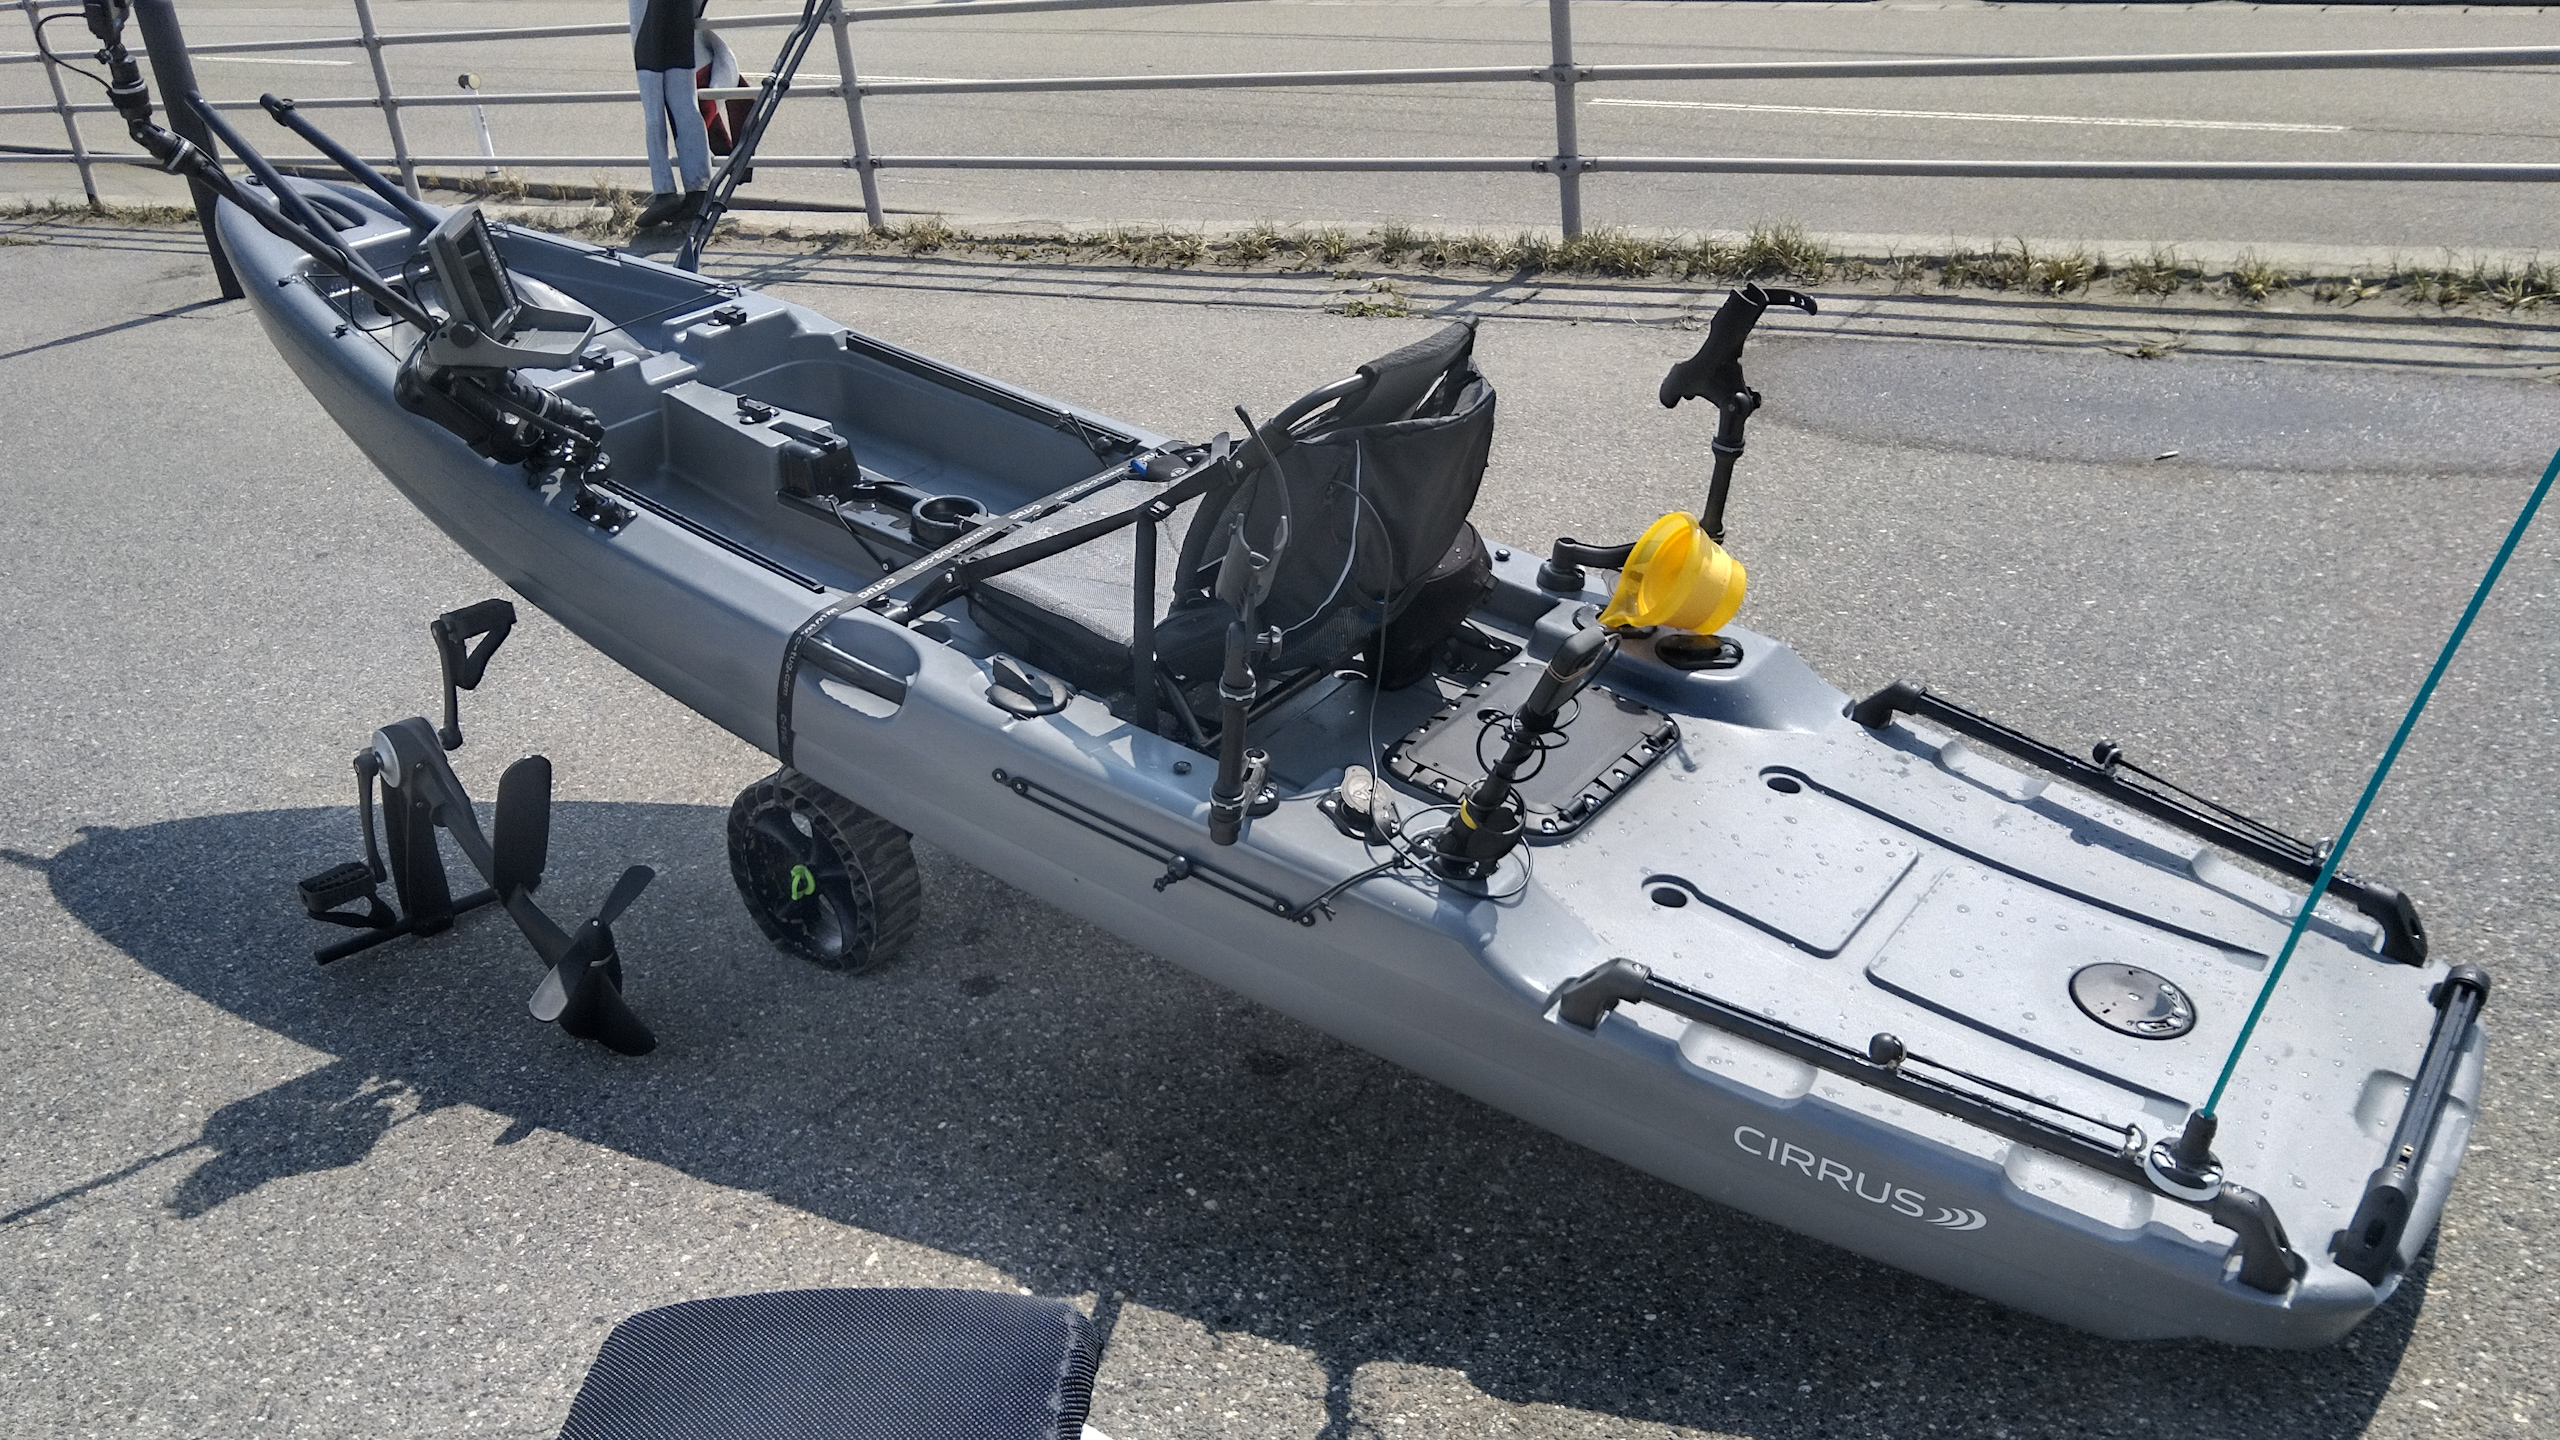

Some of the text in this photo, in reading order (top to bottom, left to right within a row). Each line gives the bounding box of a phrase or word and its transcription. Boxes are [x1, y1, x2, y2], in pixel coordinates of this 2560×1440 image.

[1009, 504, 1042, 520] C-TUG
[912, 526, 994, 571] www.c-tug.com
[857, 577, 896, 599] C-TUG
[1733, 1125, 1926, 1217] CIRRUS
